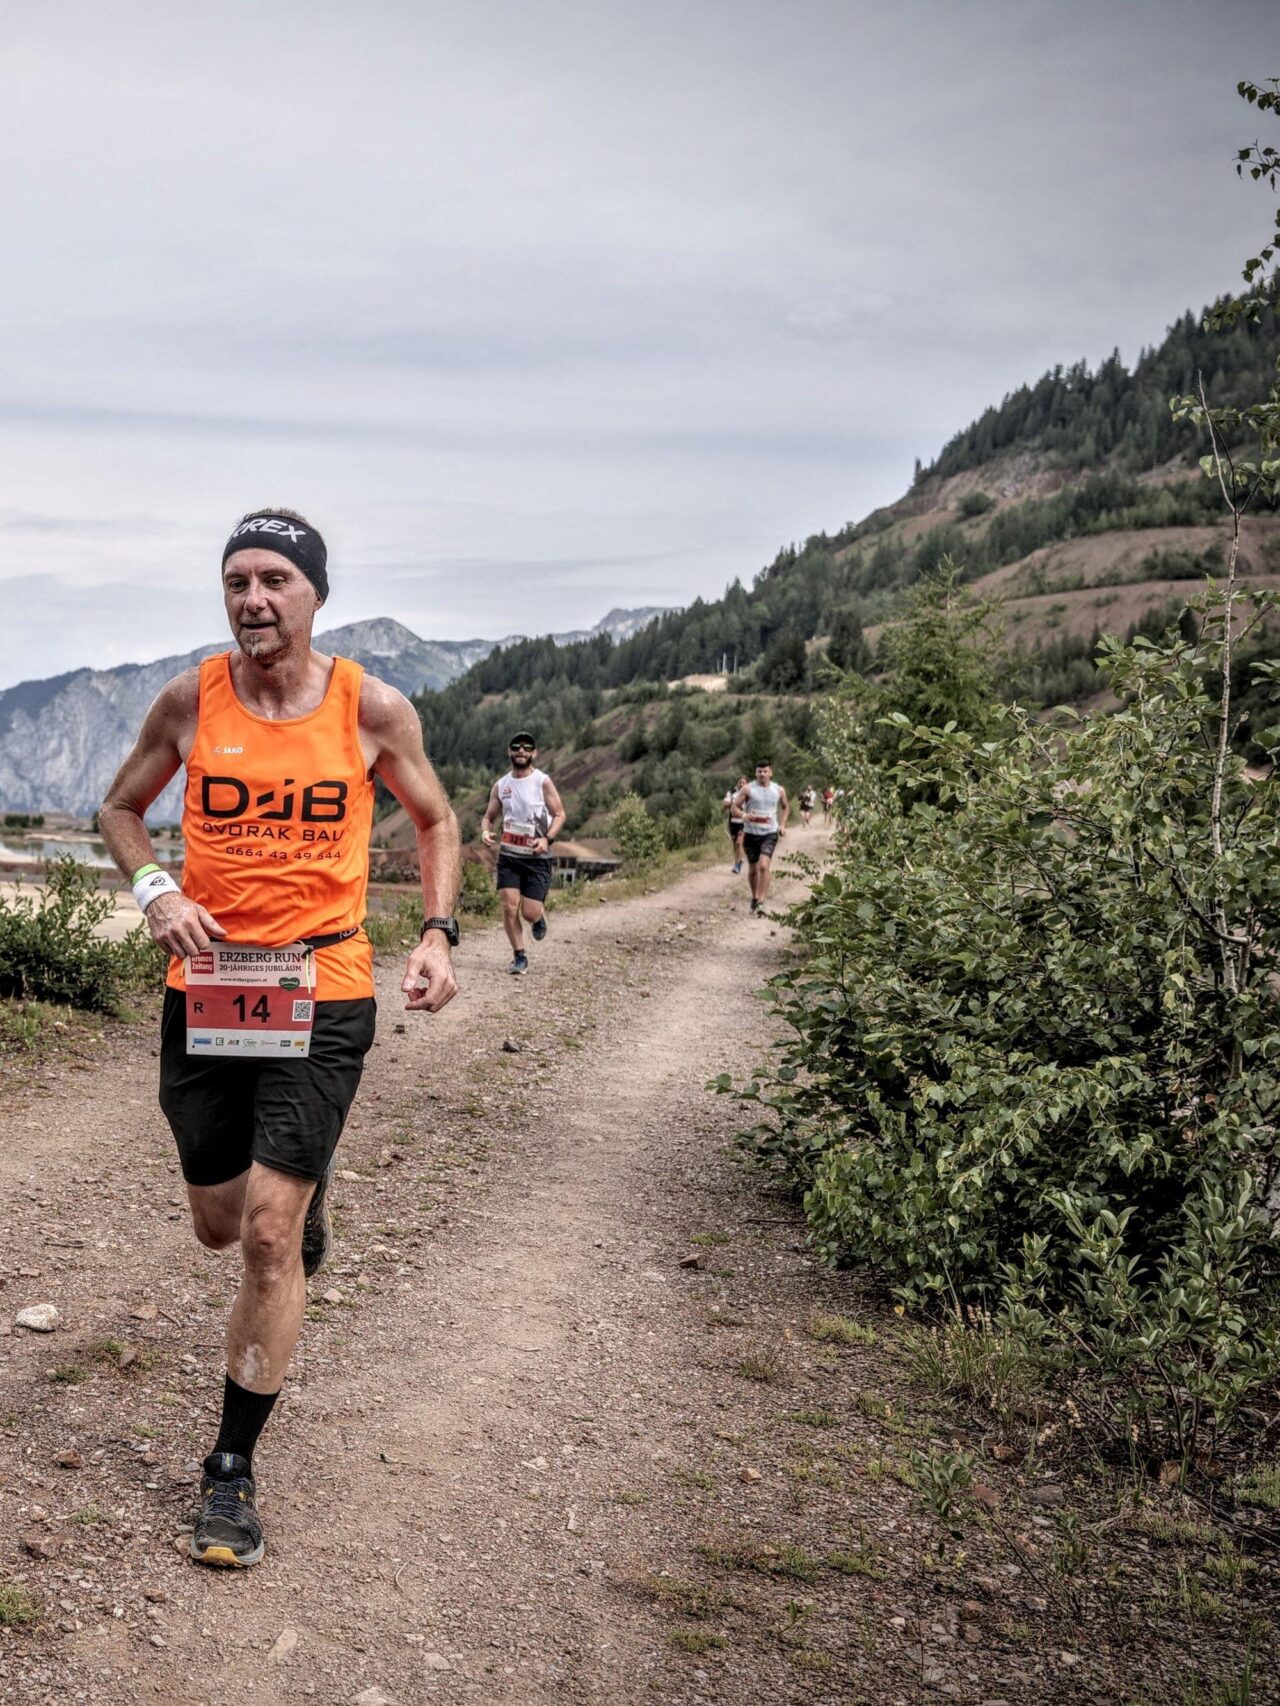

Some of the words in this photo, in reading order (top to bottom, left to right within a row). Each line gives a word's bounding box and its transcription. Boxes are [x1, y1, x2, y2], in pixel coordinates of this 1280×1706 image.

[223, 746, 244, 755] JAKO
[226, 846, 263, 858] 0664
[269, 850, 288, 860] 43
[294, 851, 312, 860] 49
[219, 951, 273, 963] ERZBERG
[278, 952, 301, 963] RUN
[191, 962, 213, 971] Zeitung
[219, 963, 265, 972] 20-JÄHRIGES
[265, 964, 302, 973] JUBILÄUM
[193, 1001, 204, 1014] R
[233, 994, 270, 1023] 14
